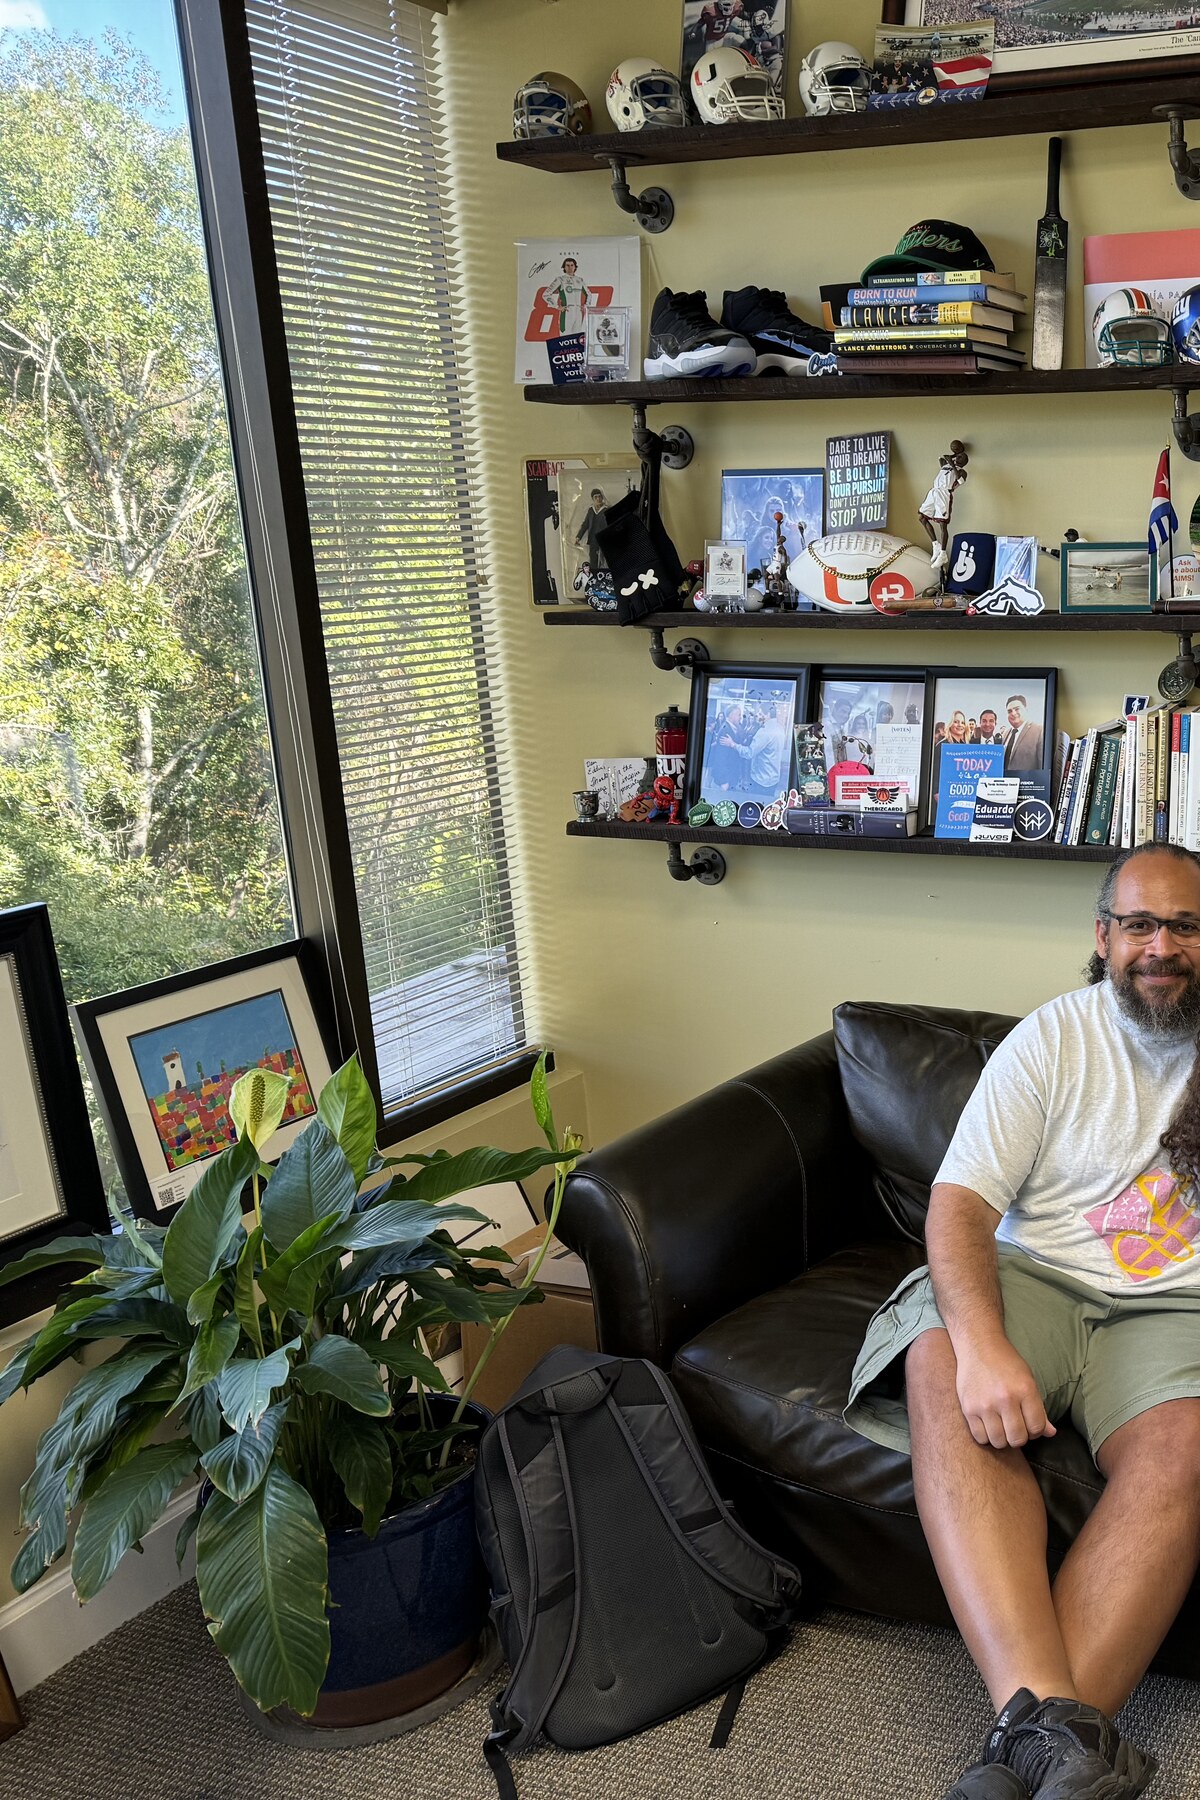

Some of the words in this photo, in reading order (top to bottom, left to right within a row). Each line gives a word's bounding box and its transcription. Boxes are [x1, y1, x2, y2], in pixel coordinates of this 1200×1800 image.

[854, 289, 882, 299] BORN
[882, 288, 895, 298] TO
[896, 288, 917, 298] RUN
[853, 306, 908, 328] LANCE
[558, 338, 578, 347] VOTE
[852, 359, 908, 367] ENDURANCE
[829, 442, 851, 456] DARE
[853, 439, 864, 452] TO
[866, 436, 886, 450] LIVE
[829, 454, 850, 468] YOUR
[852, 450, 886, 466] DREAMS
[528, 462, 564, 477] SCARFACE
[830, 470, 842, 484] BE
[846, 466, 870, 481] BOLD
[875, 464, 886, 478] IN
[830, 484, 851, 498] YOUR
[852, 478, 886, 495] PURSUIT
[830, 498, 848, 509] DON'T
[850, 496, 860, 506] LET
[861, 492, 885, 505] ANYONE
[830, 508, 856, 528] STOP
[860, 504, 885, 523] YOU.
[1100, 740, 1110, 766] Modern
[656, 758, 686, 776] RUN
[954, 758, 992, 772] TODAY
[950, 784, 974, 796] GOOD
[1095, 768, 1105, 806] Portuguese
[948, 811, 970, 822] GOOD
[975, 804, 1014, 814] Eduardo
[1060, 807, 1068, 824] GODIN
[1108, 1214, 1146, 1224] HEALTH
